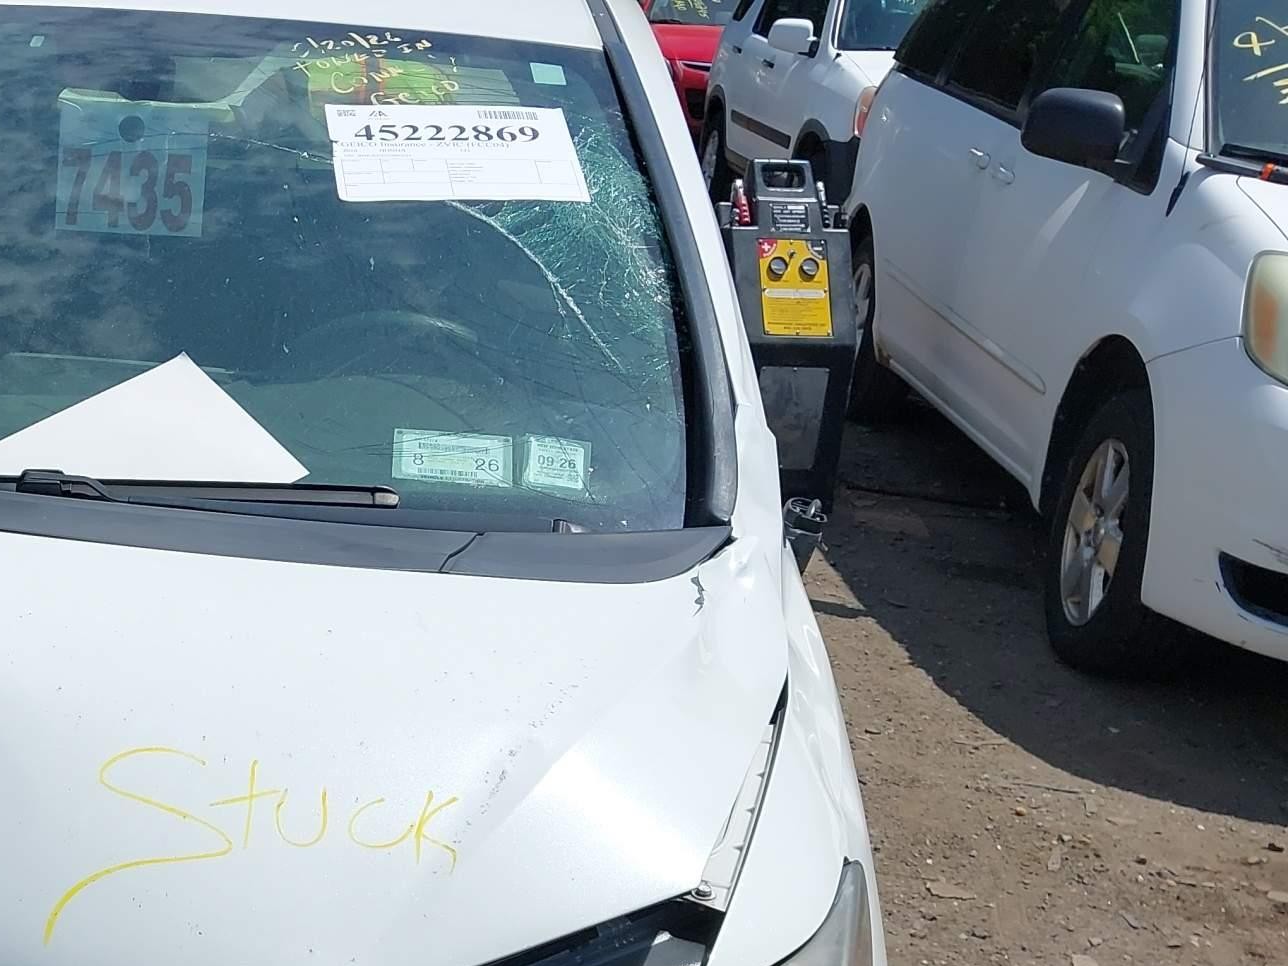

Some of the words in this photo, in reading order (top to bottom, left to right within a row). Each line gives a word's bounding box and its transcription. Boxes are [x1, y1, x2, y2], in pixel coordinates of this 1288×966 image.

[354, 123, 540, 142] 45222869
[62, 148, 193, 232] 7435
[412, 453, 424, 466] 8
[474, 457, 500, 472] 26
[537, 454, 554, 467] 09
[559, 457, 577, 469] 26
